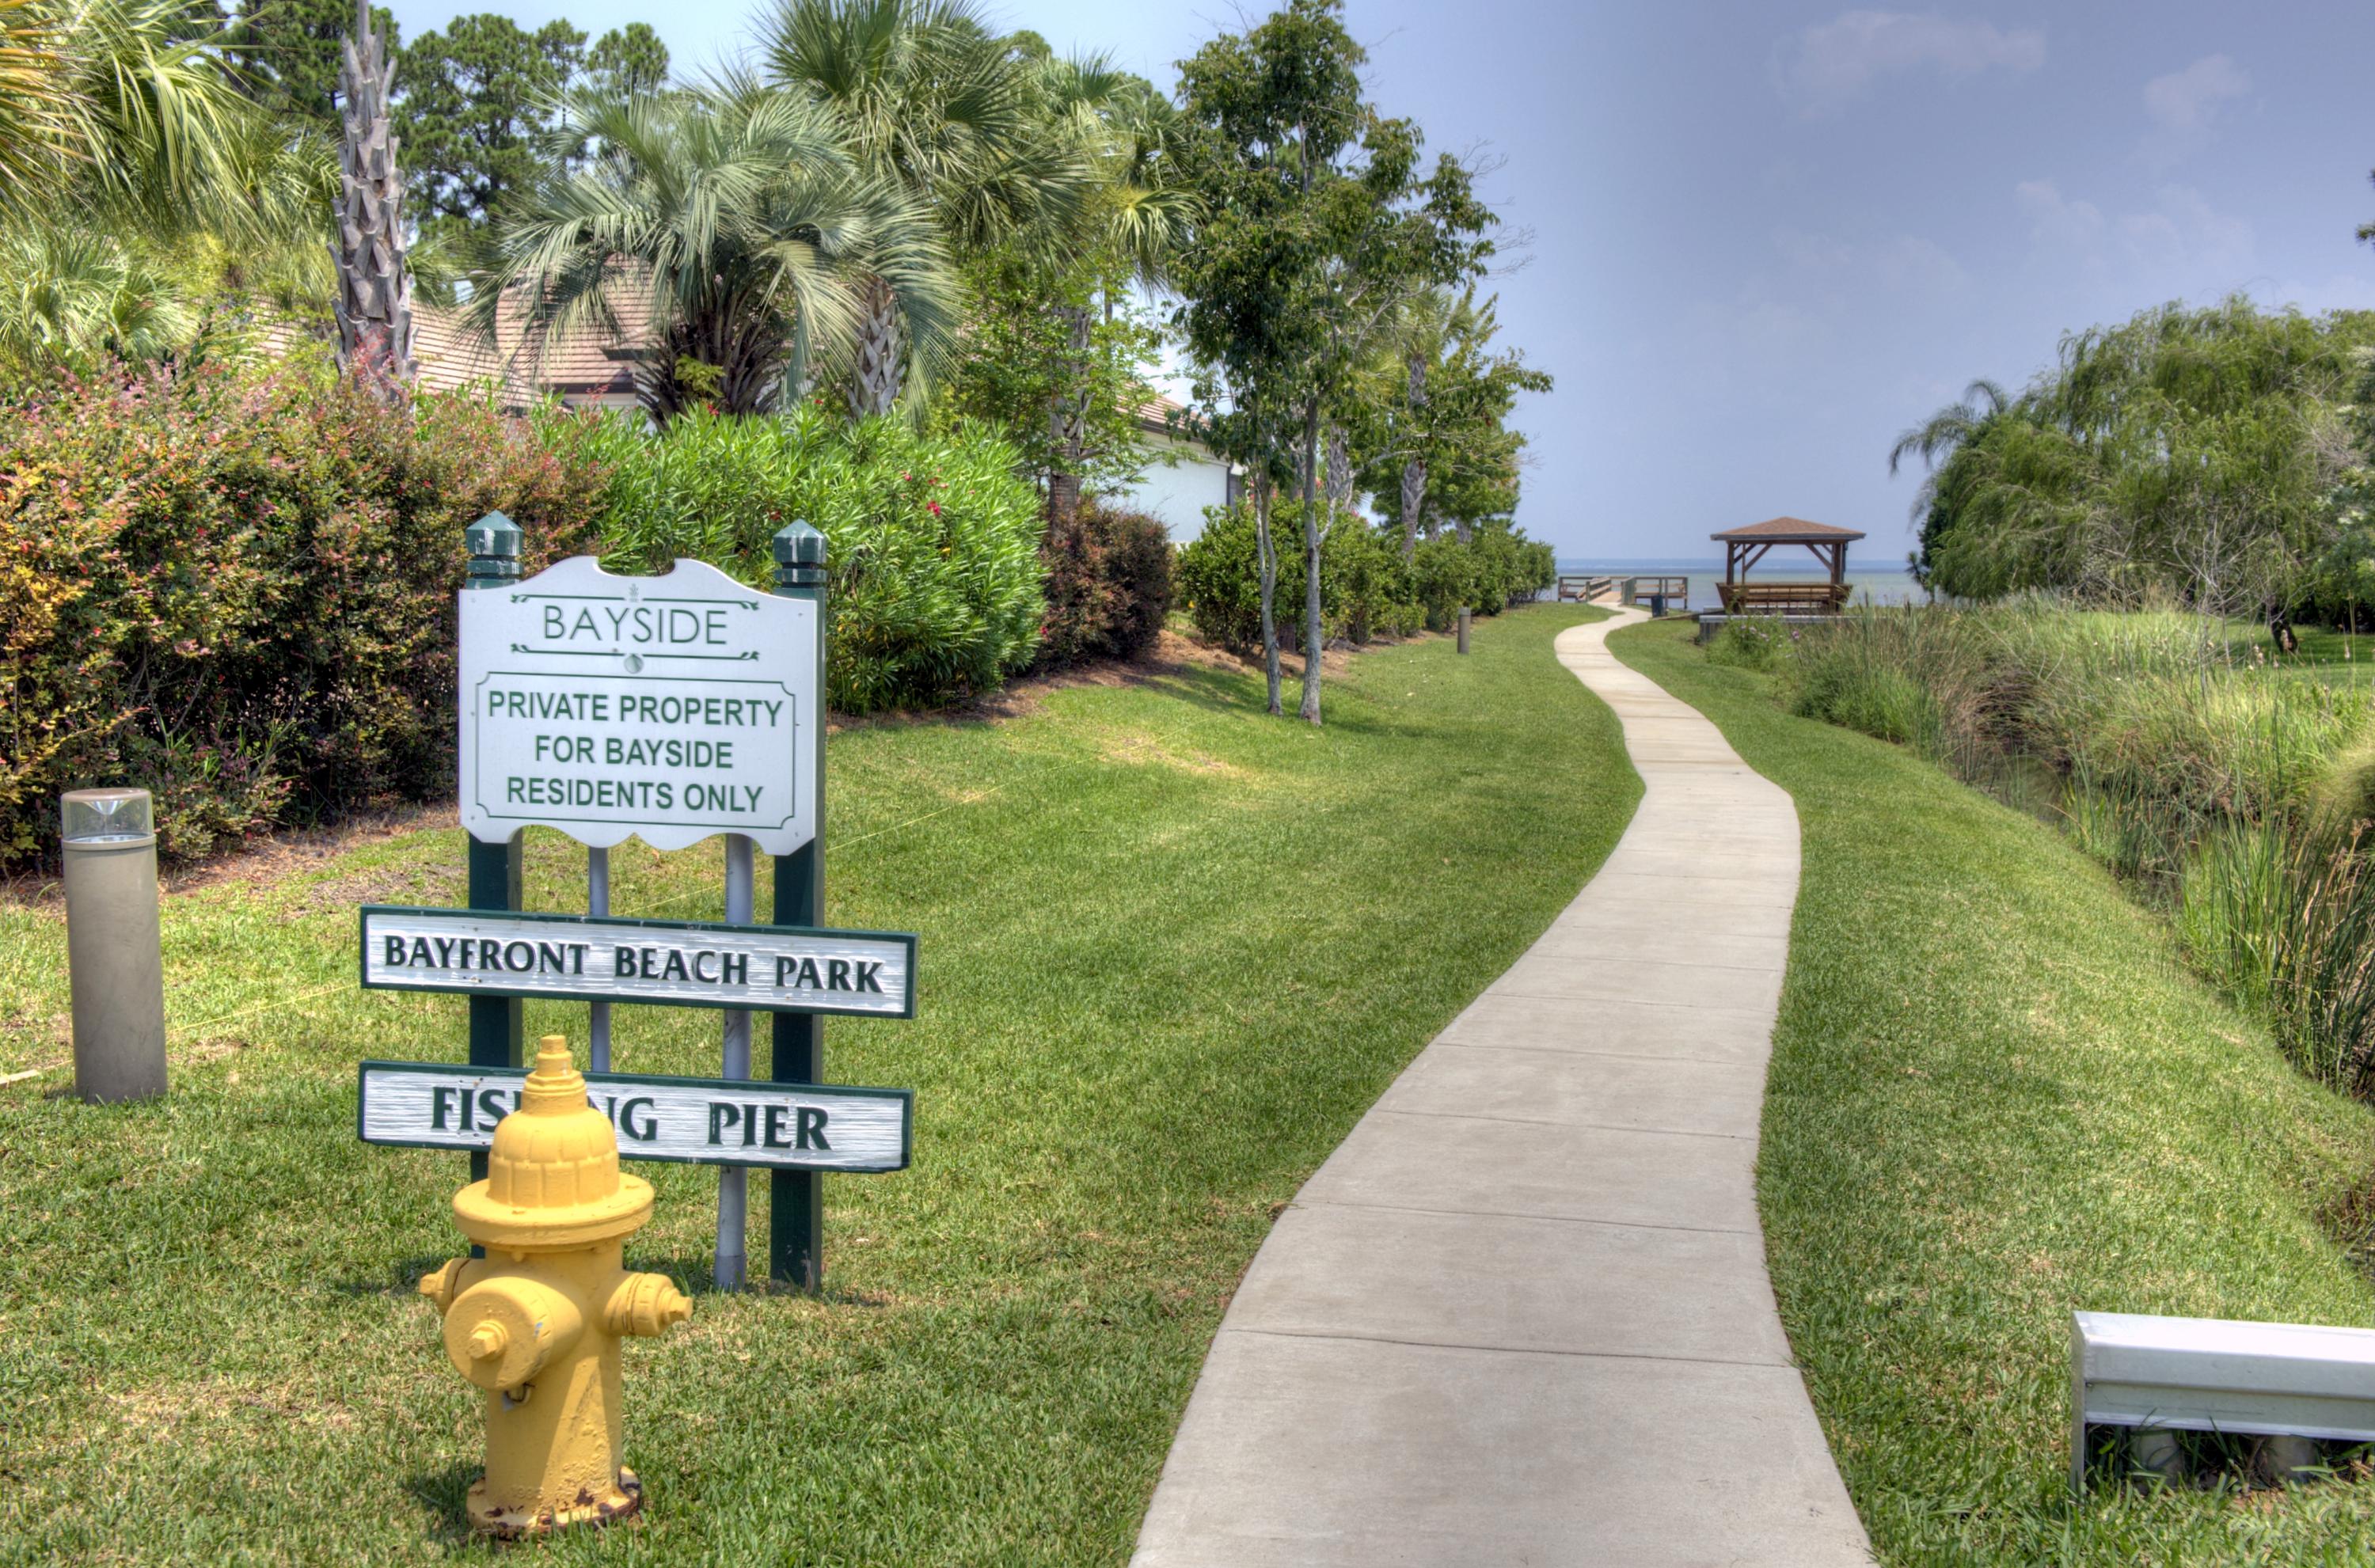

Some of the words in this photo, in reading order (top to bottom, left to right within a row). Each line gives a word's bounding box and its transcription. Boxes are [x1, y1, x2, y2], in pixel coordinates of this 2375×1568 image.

[544, 605, 728, 644] BAYSIDE
[489, 690, 608, 721] PRIVATE
[620, 695, 783, 727] PROPERTY
[536, 735, 595, 764] FOR
[606, 738, 733, 769] BAYSIDE
[507, 776, 673, 810] RESIDENTS
[684, 783, 764, 813] ONLY
[386, 936, 587, 974] BAYFRONT
[614, 946, 747, 985] BEACH
[776, 955, 881, 993] PARK
[431, 1086, 657, 1141] FISG
[708, 1102, 831, 1150] PIER
